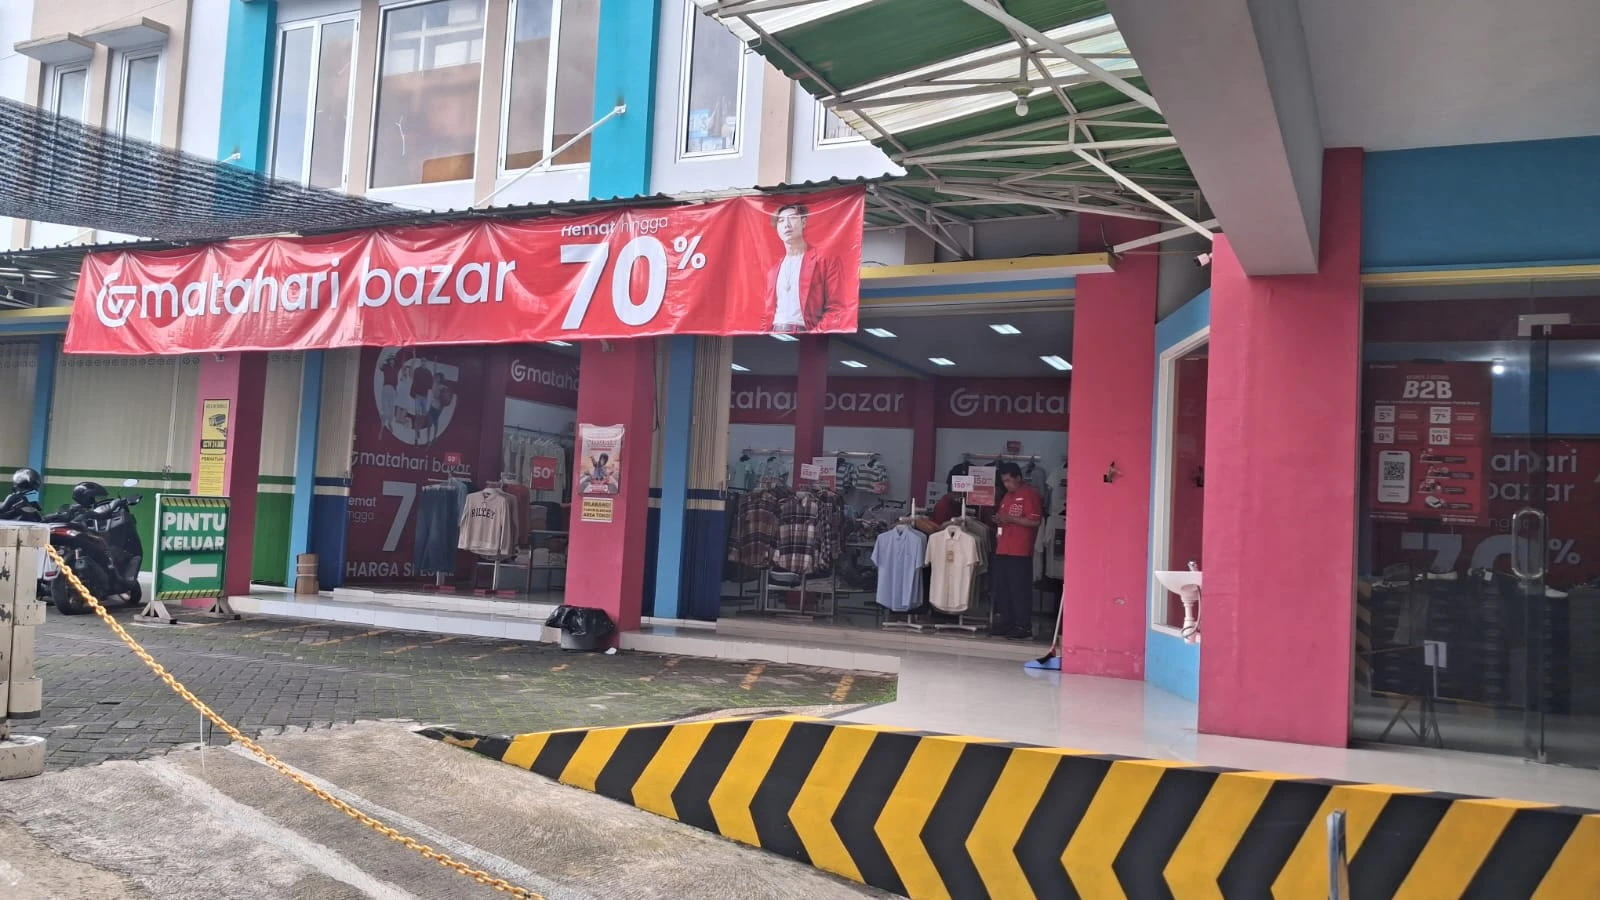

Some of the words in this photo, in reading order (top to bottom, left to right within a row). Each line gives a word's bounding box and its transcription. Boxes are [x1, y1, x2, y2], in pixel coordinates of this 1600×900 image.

[620, 216, 669, 236] hingga
[140, 258, 340, 319] matahari
[357, 256, 516, 308] bazar
[527, 367, 579, 392] mataha
[729, 387, 797, 411] taha
[1403, 380, 1452, 399] B2B
[983, 393, 1065, 415] mata
[360, 452, 428, 471] matahari
[348, 496, 377, 507] emat
[162, 512, 227, 531] PINTU
[347, 510, 375, 523] ngga
[382, 480, 417, 552] 7
[161, 536, 225, 551] KELUAR
[346, 561, 399, 577] HARGA
